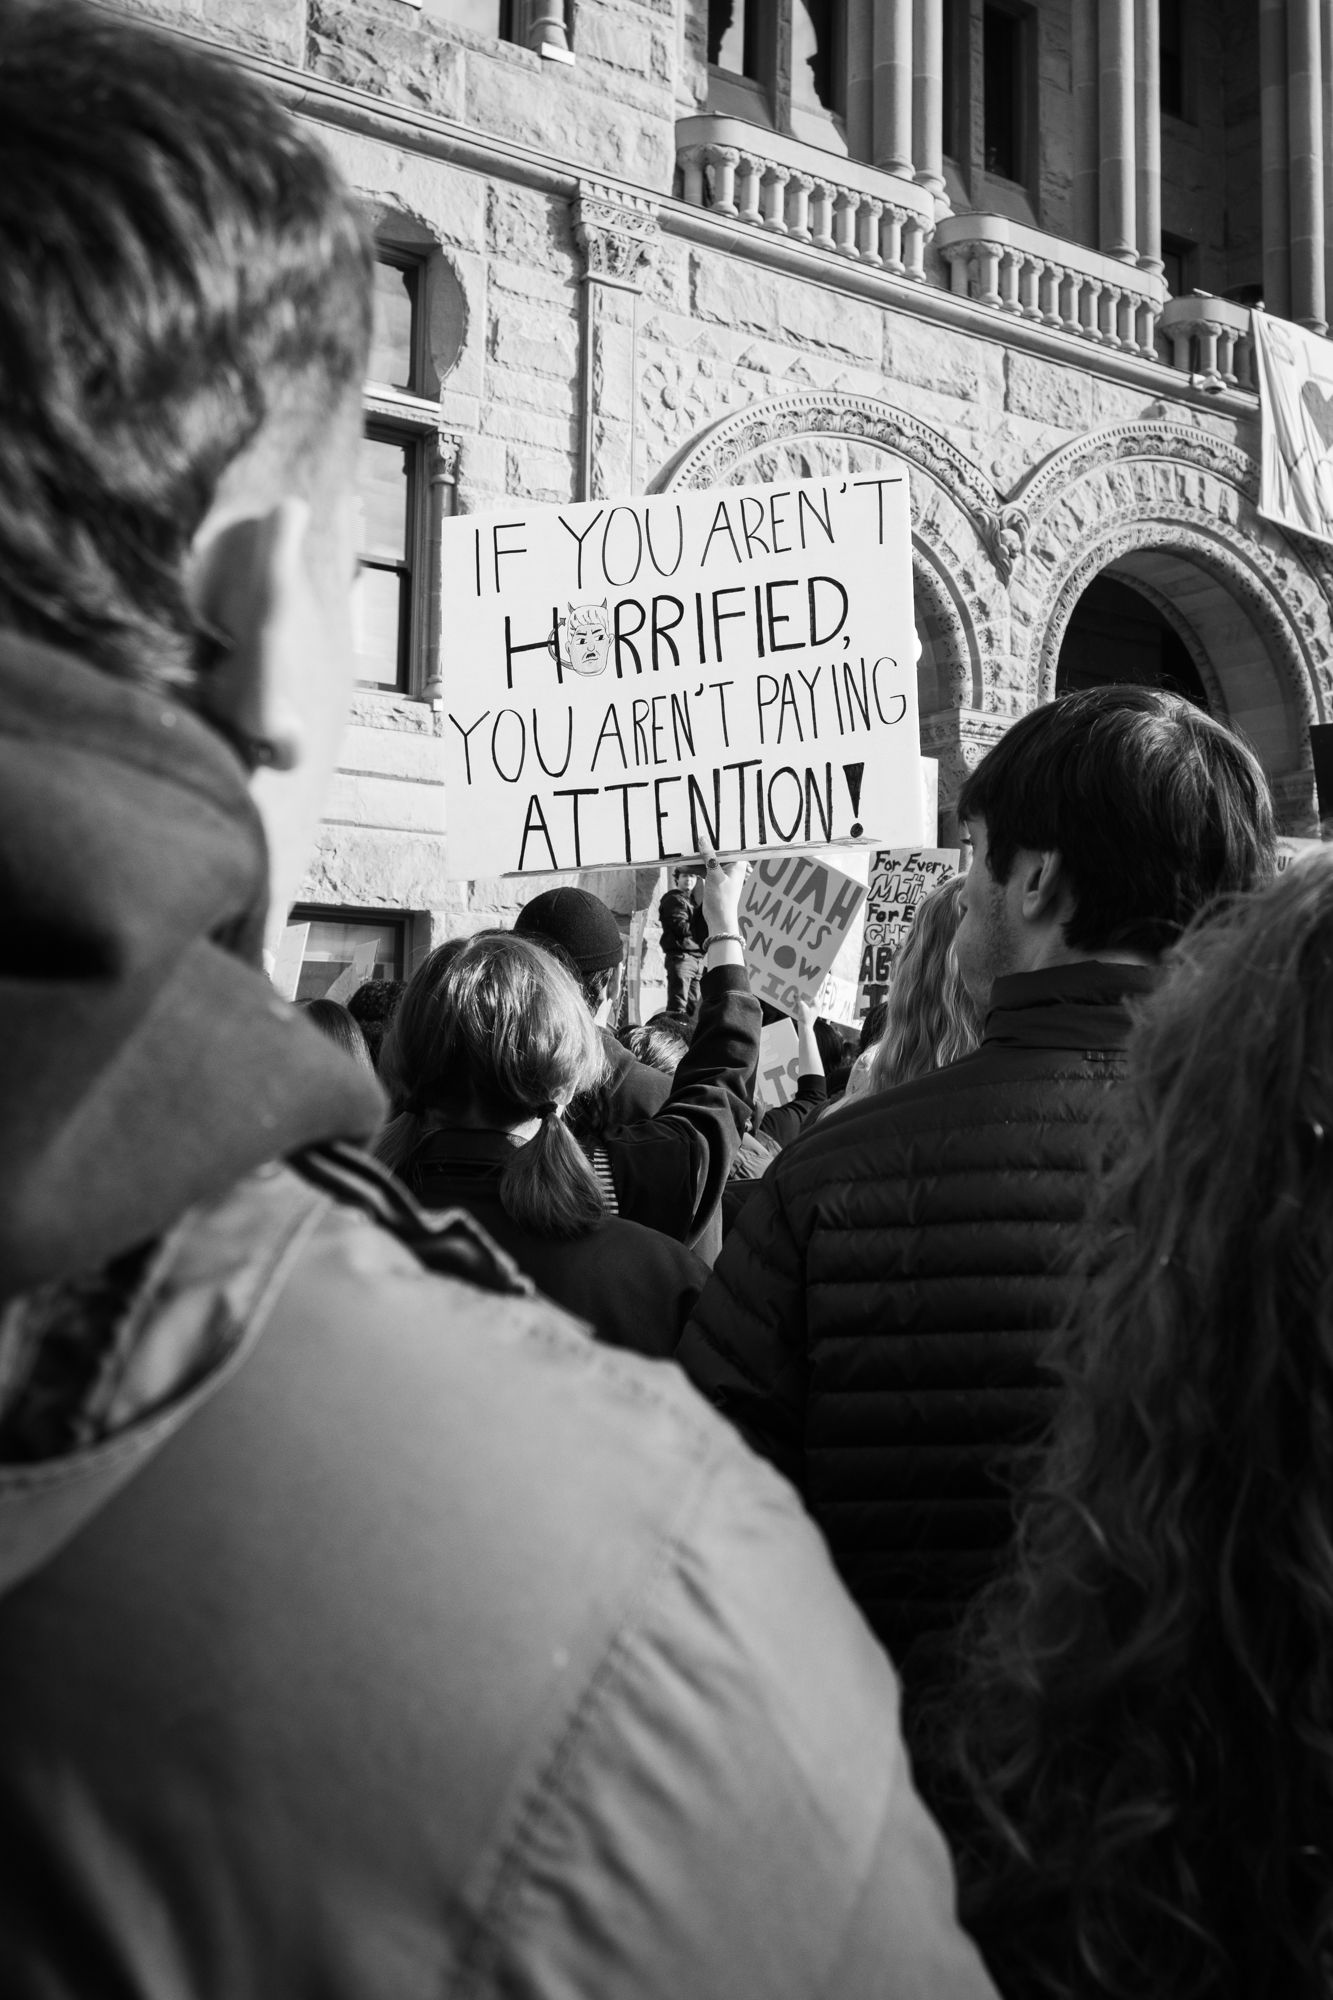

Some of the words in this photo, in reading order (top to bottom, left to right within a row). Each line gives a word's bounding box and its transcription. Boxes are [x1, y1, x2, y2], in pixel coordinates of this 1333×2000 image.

[475, 522, 527, 596] IF
[558, 505, 684, 590] YOU
[700, 478, 903, 567] AREN'T
[448, 706, 574, 785] YOU
[590, 681, 735, 772] AREN'T
[756, 656, 907, 744] PAYING
[518, 759, 866, 870] ATTENTION!
[759, 857, 864, 931] UTAH
[866, 873, 929, 905] Moth
[871, 850, 902, 873] For
[902, 853, 953, 881] Every
[745, 882, 832, 950] WANTS
[866, 903, 899, 922] For
